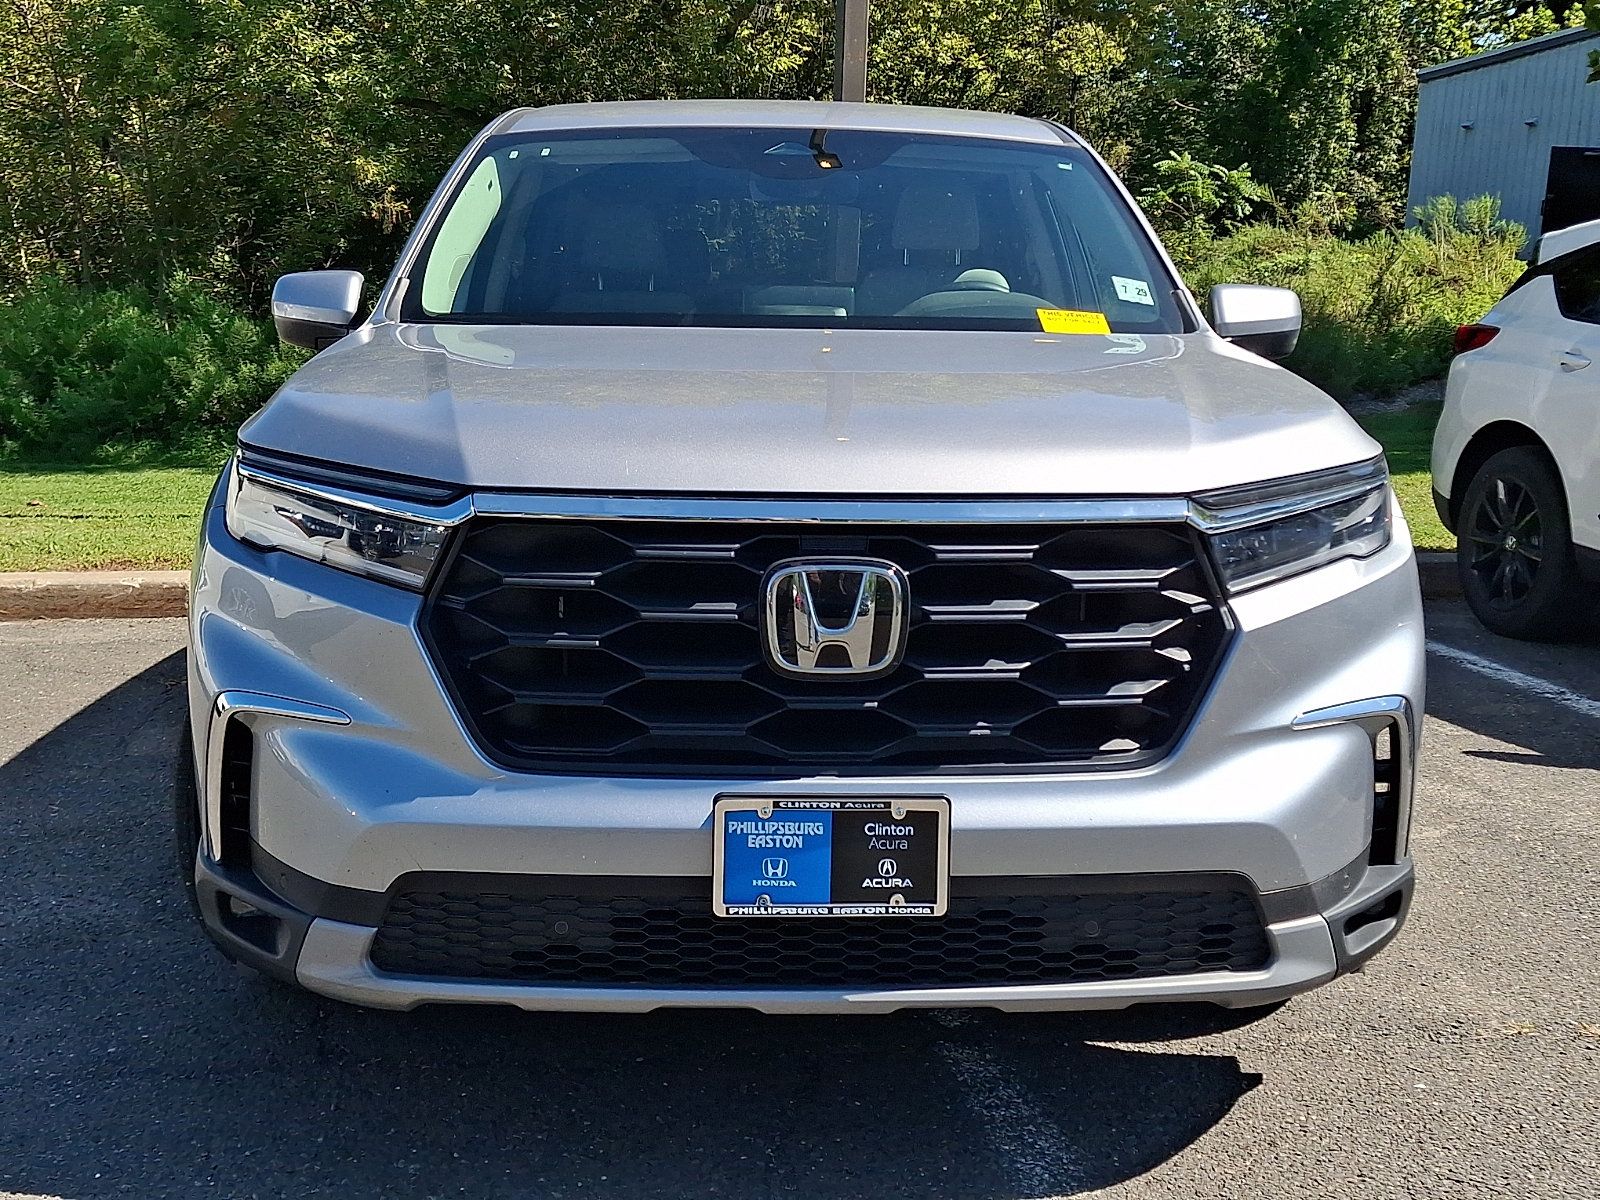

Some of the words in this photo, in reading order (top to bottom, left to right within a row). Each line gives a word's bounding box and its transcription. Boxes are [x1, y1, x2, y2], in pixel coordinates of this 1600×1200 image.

[779, 801, 841, 809] CLINTON
[728, 821, 824, 836] PHILLIPSBURG
[864, 823, 914, 836] Clinton
[747, 835, 803, 849] EASTON
[868, 837, 908, 850] Acura
[752, 879, 797, 887] HONDA
[862, 879, 914, 888] ACURA
[729, 906, 829, 915] PHILLIPSBURG
[832, 906, 886, 915] EASTON
